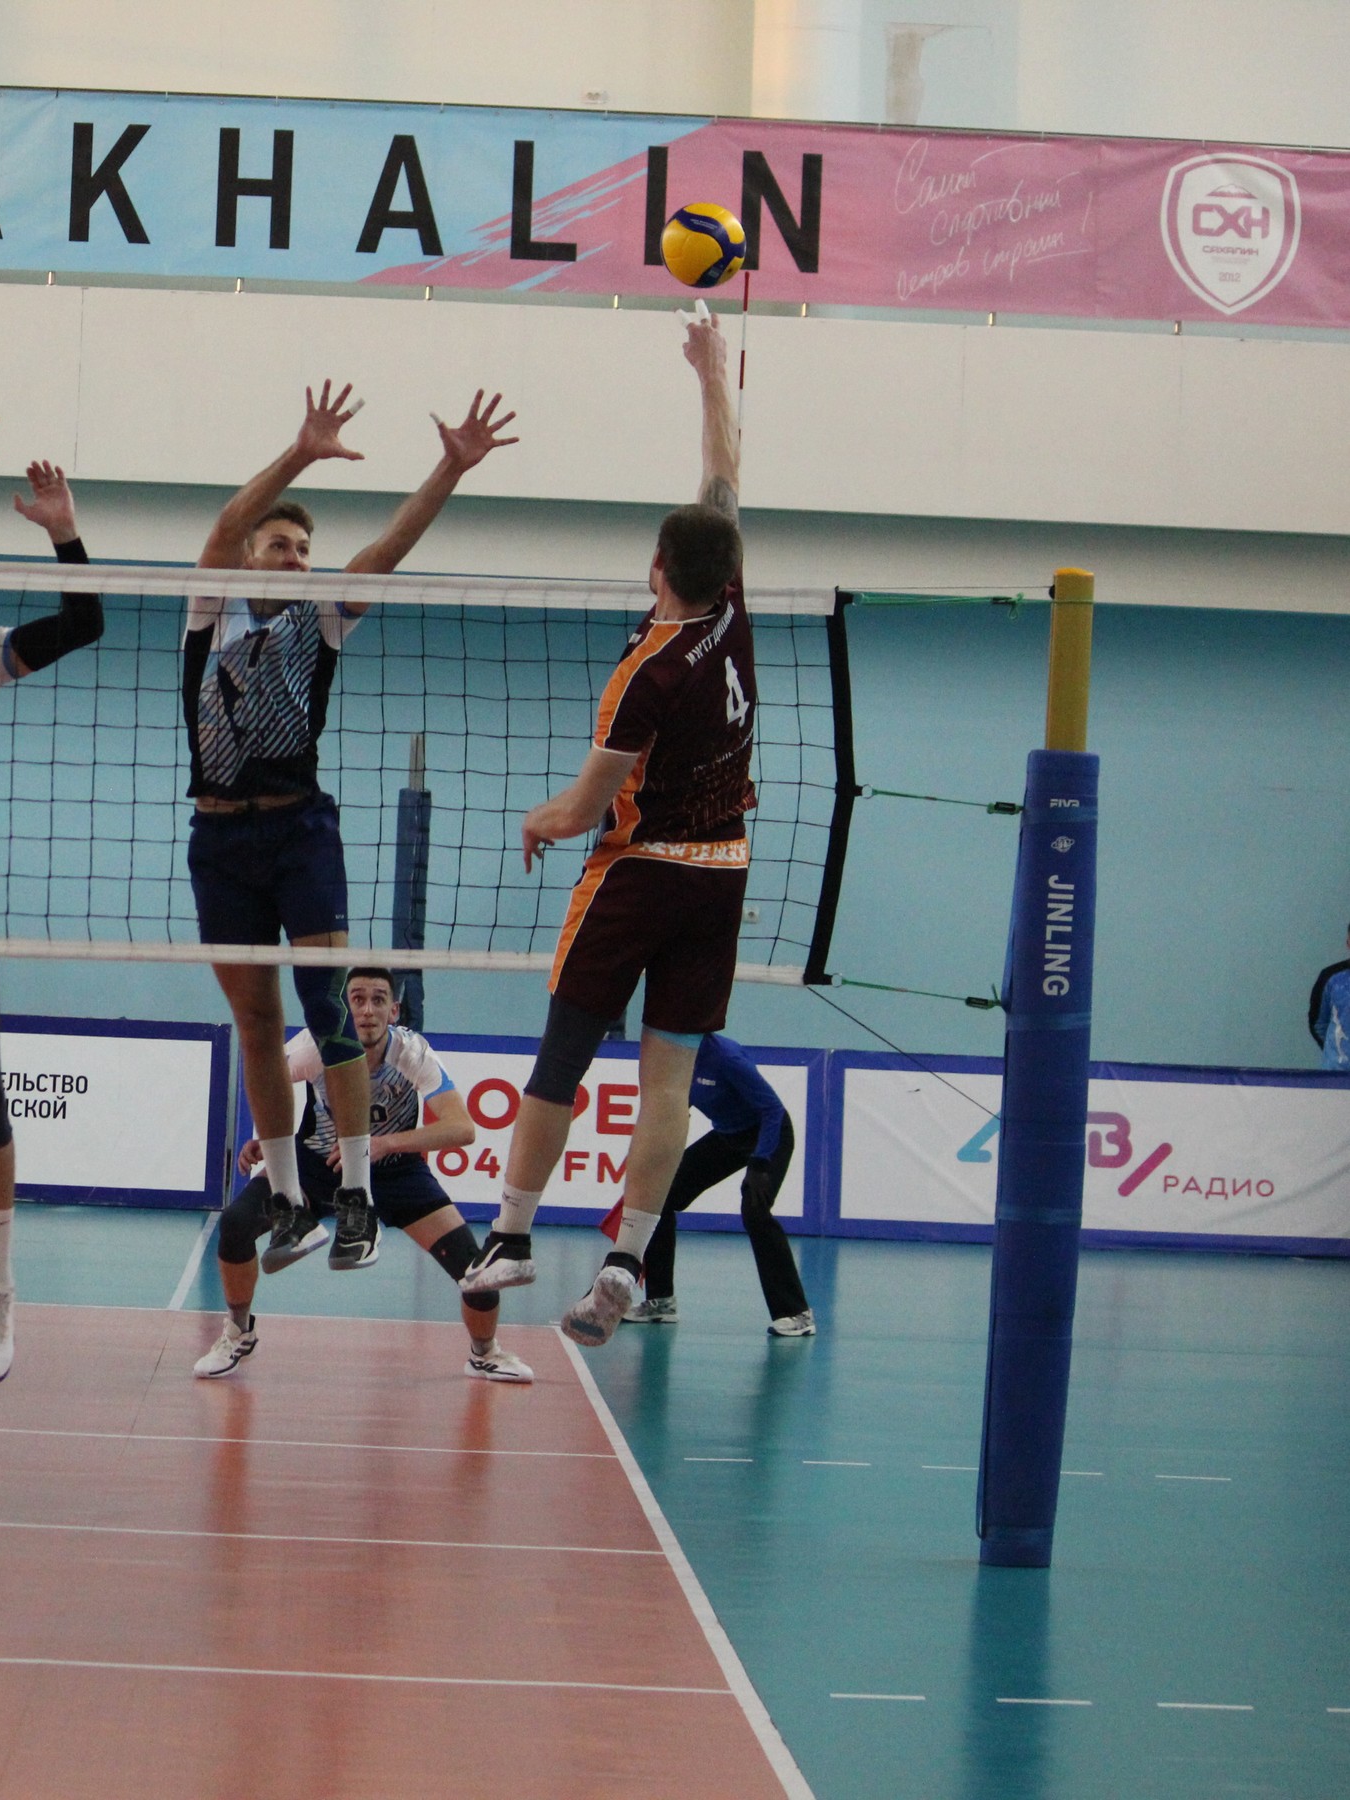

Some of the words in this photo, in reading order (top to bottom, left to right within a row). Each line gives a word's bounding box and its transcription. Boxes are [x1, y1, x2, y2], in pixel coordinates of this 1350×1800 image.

[725, 655, 750, 728] 4
[1043, 875, 1075, 997] JINLING
[1163, 1175, 1275, 1200] РАДИО
